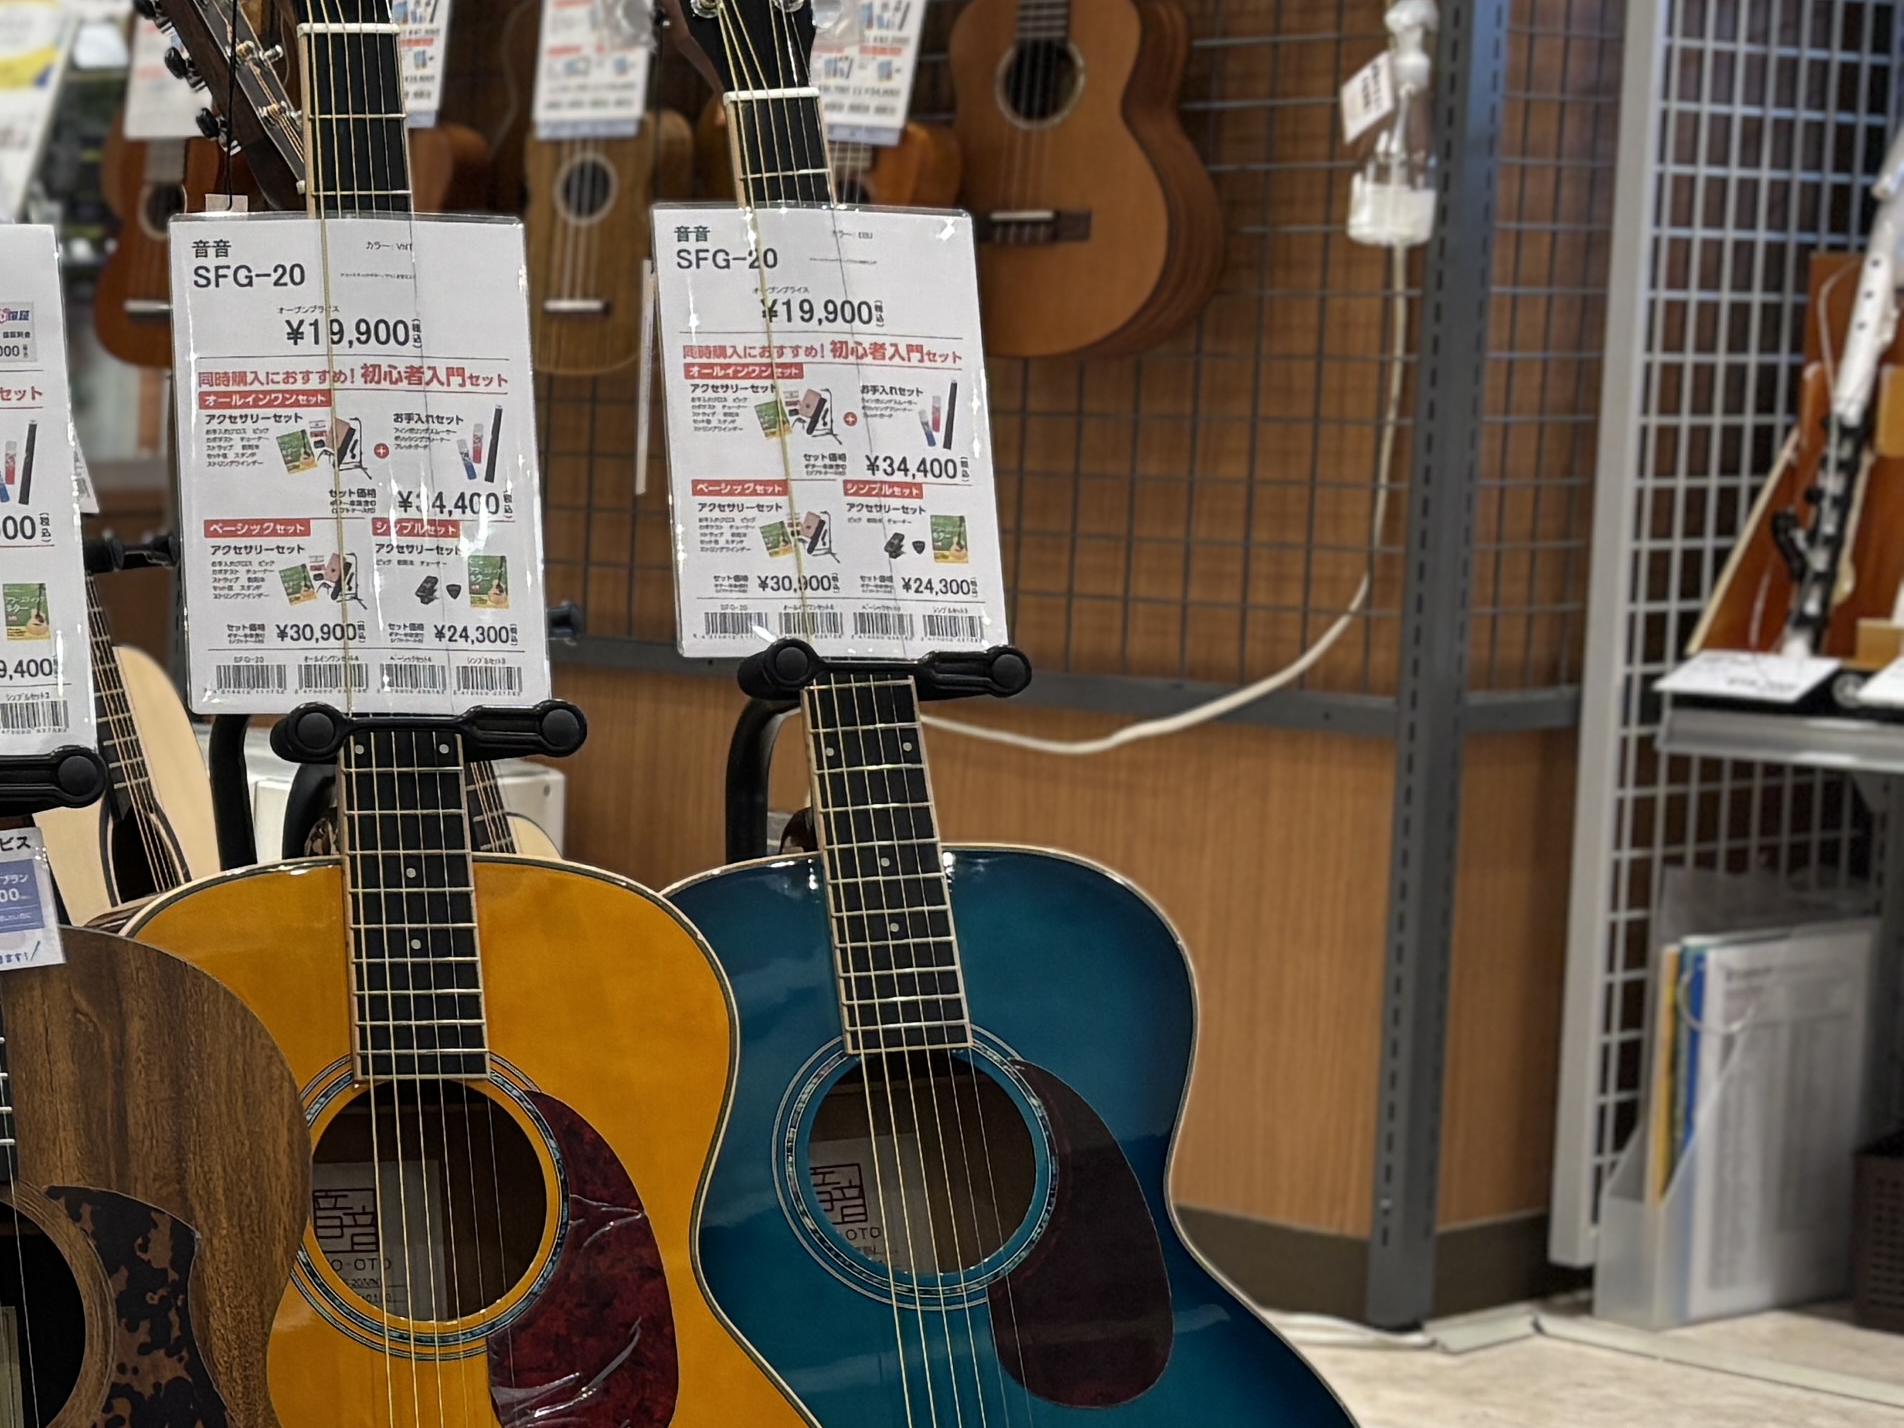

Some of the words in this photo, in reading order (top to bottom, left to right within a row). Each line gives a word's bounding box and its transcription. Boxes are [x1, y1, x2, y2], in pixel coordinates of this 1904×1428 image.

[192, 240, 231, 258] 音音
[676, 248, 778, 269] SFG-20
[193, 264, 305, 288] SFG-20
[761, 299, 872, 326] ¥19,900
[286, 317, 410, 349] ¥19,900
[360, 363, 508, 387] 初心者入門セット
[865, 455, 957, 479] ¥34,400
[902, 577, 970, 596] ¥24,300
[276, 623, 357, 642] ¥30,900
[433, 625, 510, 644] ¥24,300
